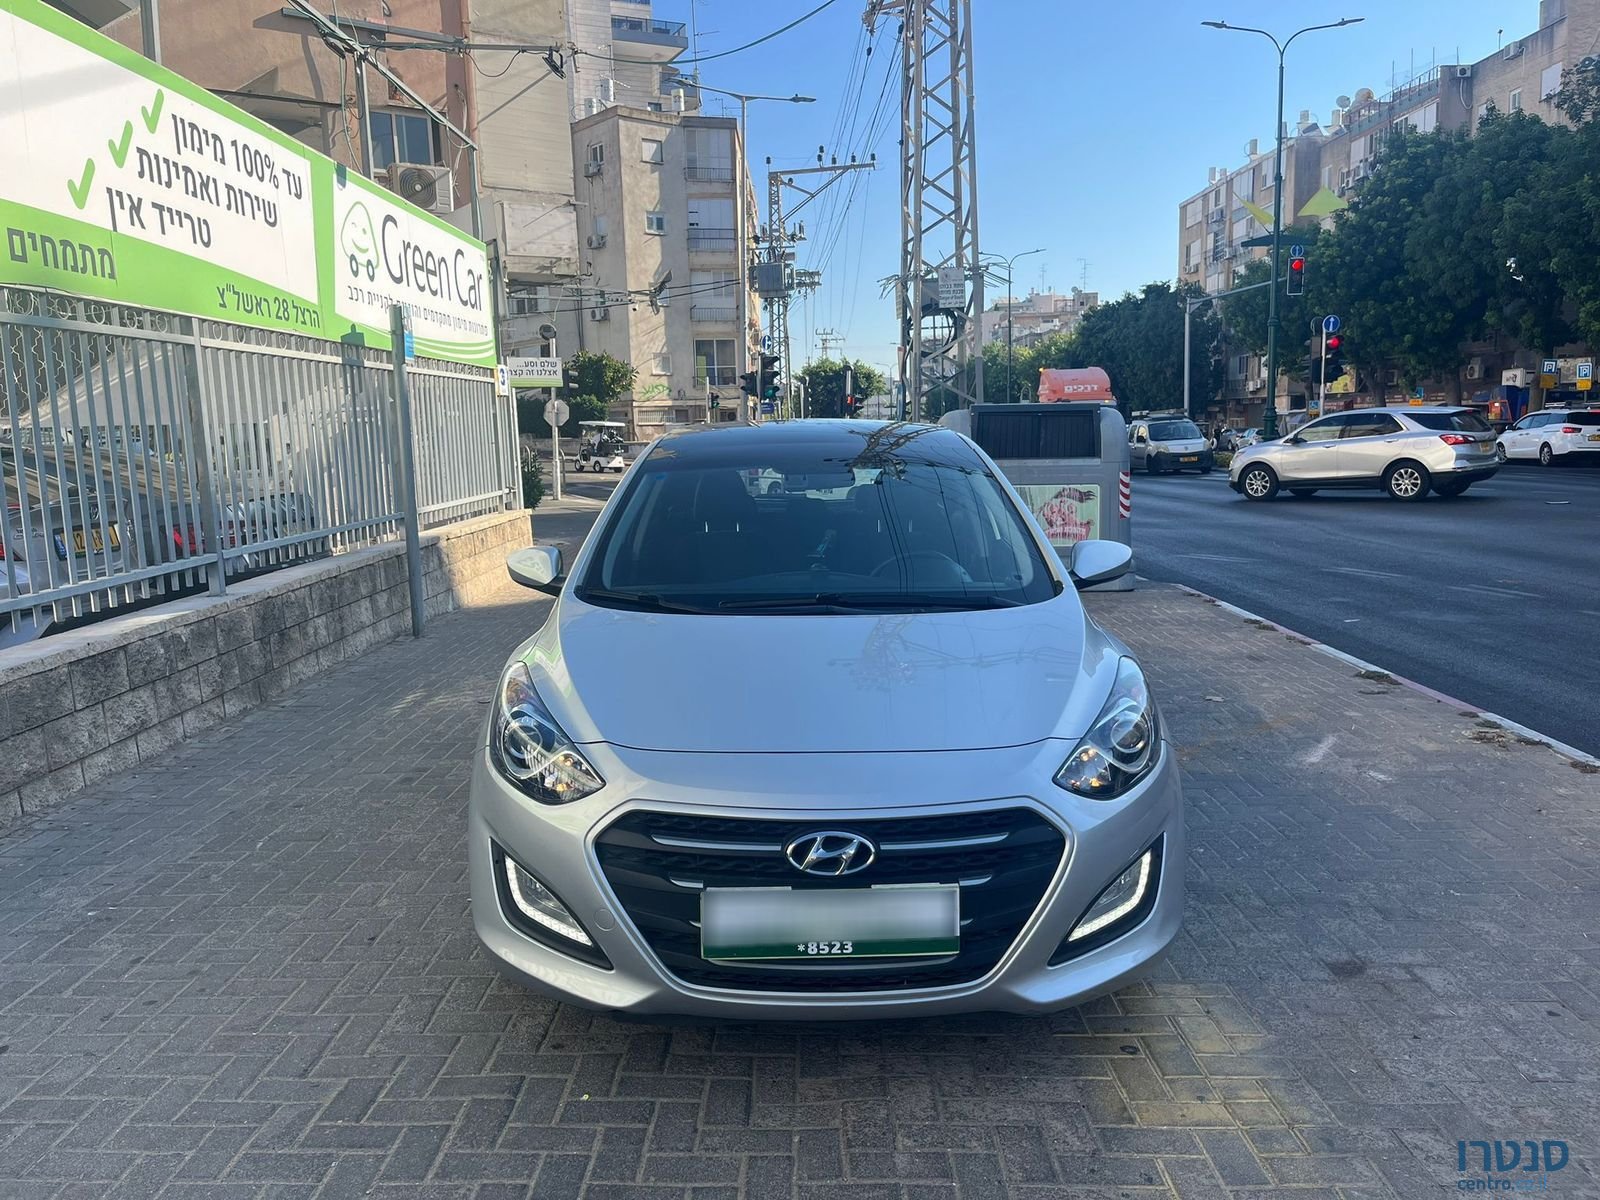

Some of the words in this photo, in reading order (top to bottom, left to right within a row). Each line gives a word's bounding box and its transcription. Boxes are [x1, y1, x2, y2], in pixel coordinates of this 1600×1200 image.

[171, 113, 226, 166] מימון
[136, 147, 220, 207] ואמינות
[231, 139, 279, 190] 100%
[282, 168, 302, 200] עד
[106, 187, 146, 232] אין
[151, 201, 212, 248] טרייד
[224, 183, 278, 228] שירות
[7, 227, 117, 280] מתמחים
[381, 214, 452, 301] Green
[454, 248, 483, 312] Car
[273, 297, 290, 322] 28
[347, 285, 365, 304] רכב
[291, 300, 321, 329] הרצל
[509, 369, 524, 377] קצר
[516, 360, 538, 368] וסע...
[536, 368, 558, 376] אצלנו
[540, 360, 557, 368] שלם
